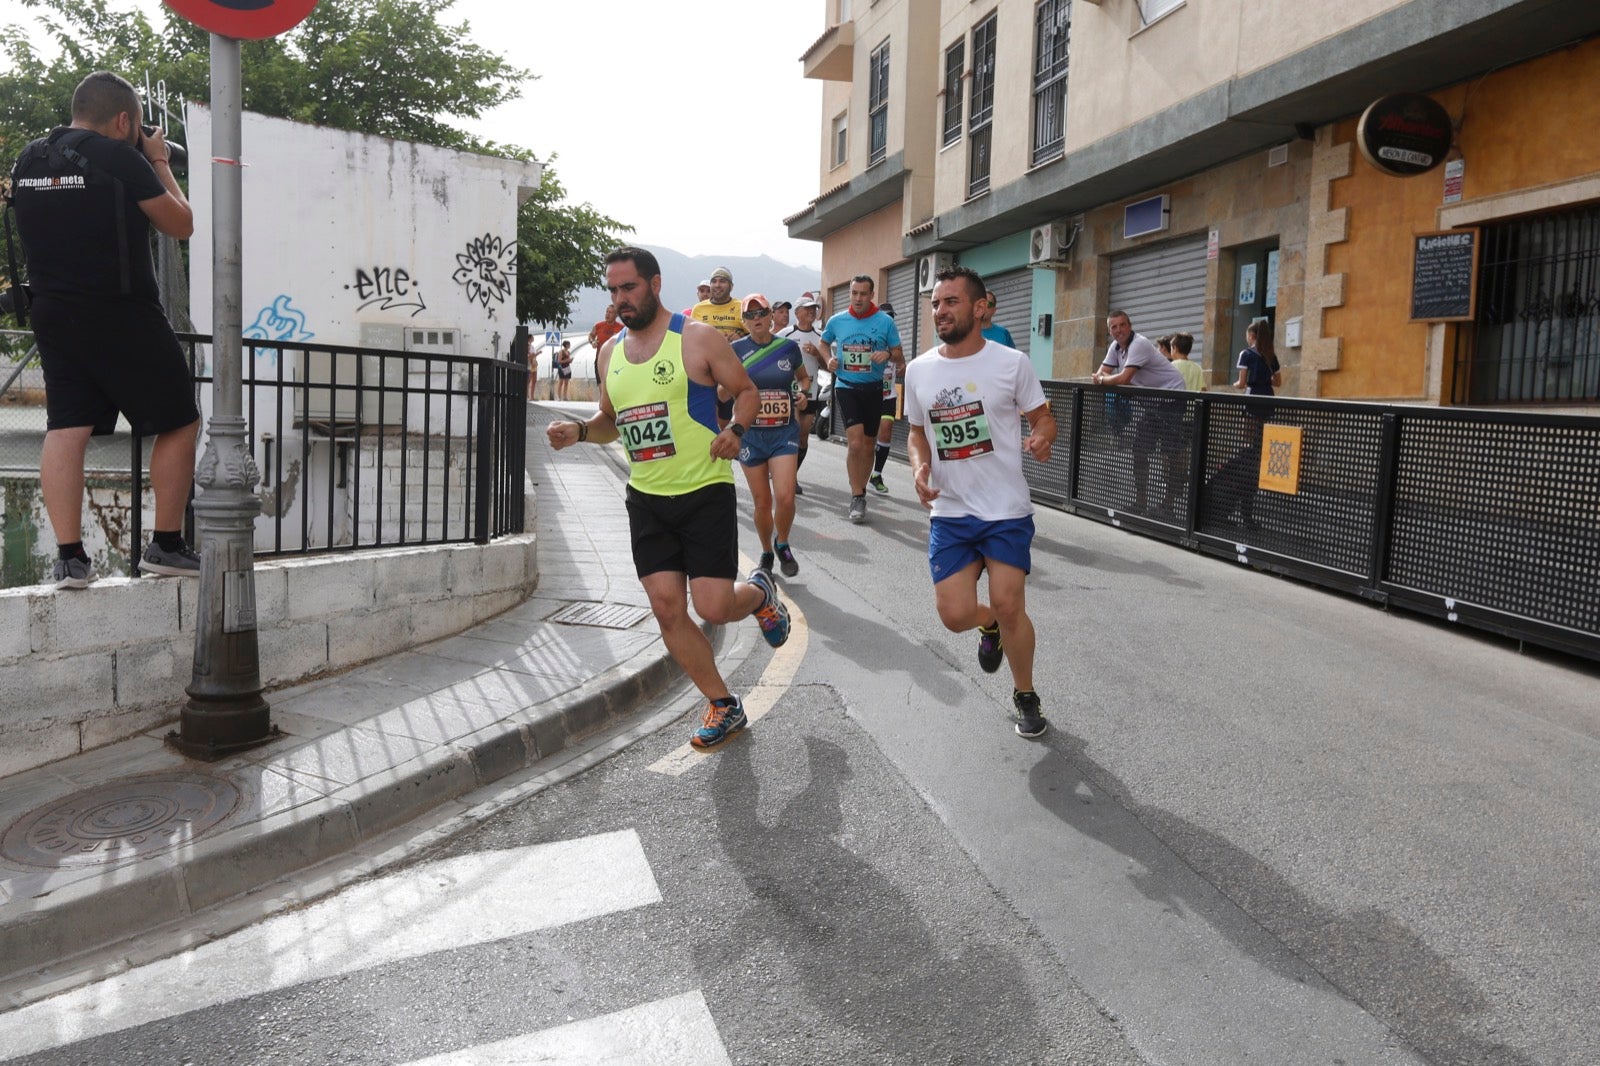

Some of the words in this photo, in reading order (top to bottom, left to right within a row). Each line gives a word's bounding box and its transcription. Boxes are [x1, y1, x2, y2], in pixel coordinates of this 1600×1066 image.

[850, 353, 862, 363] 31
[623, 420, 671, 447] 1042
[941, 420, 979, 444] 995
